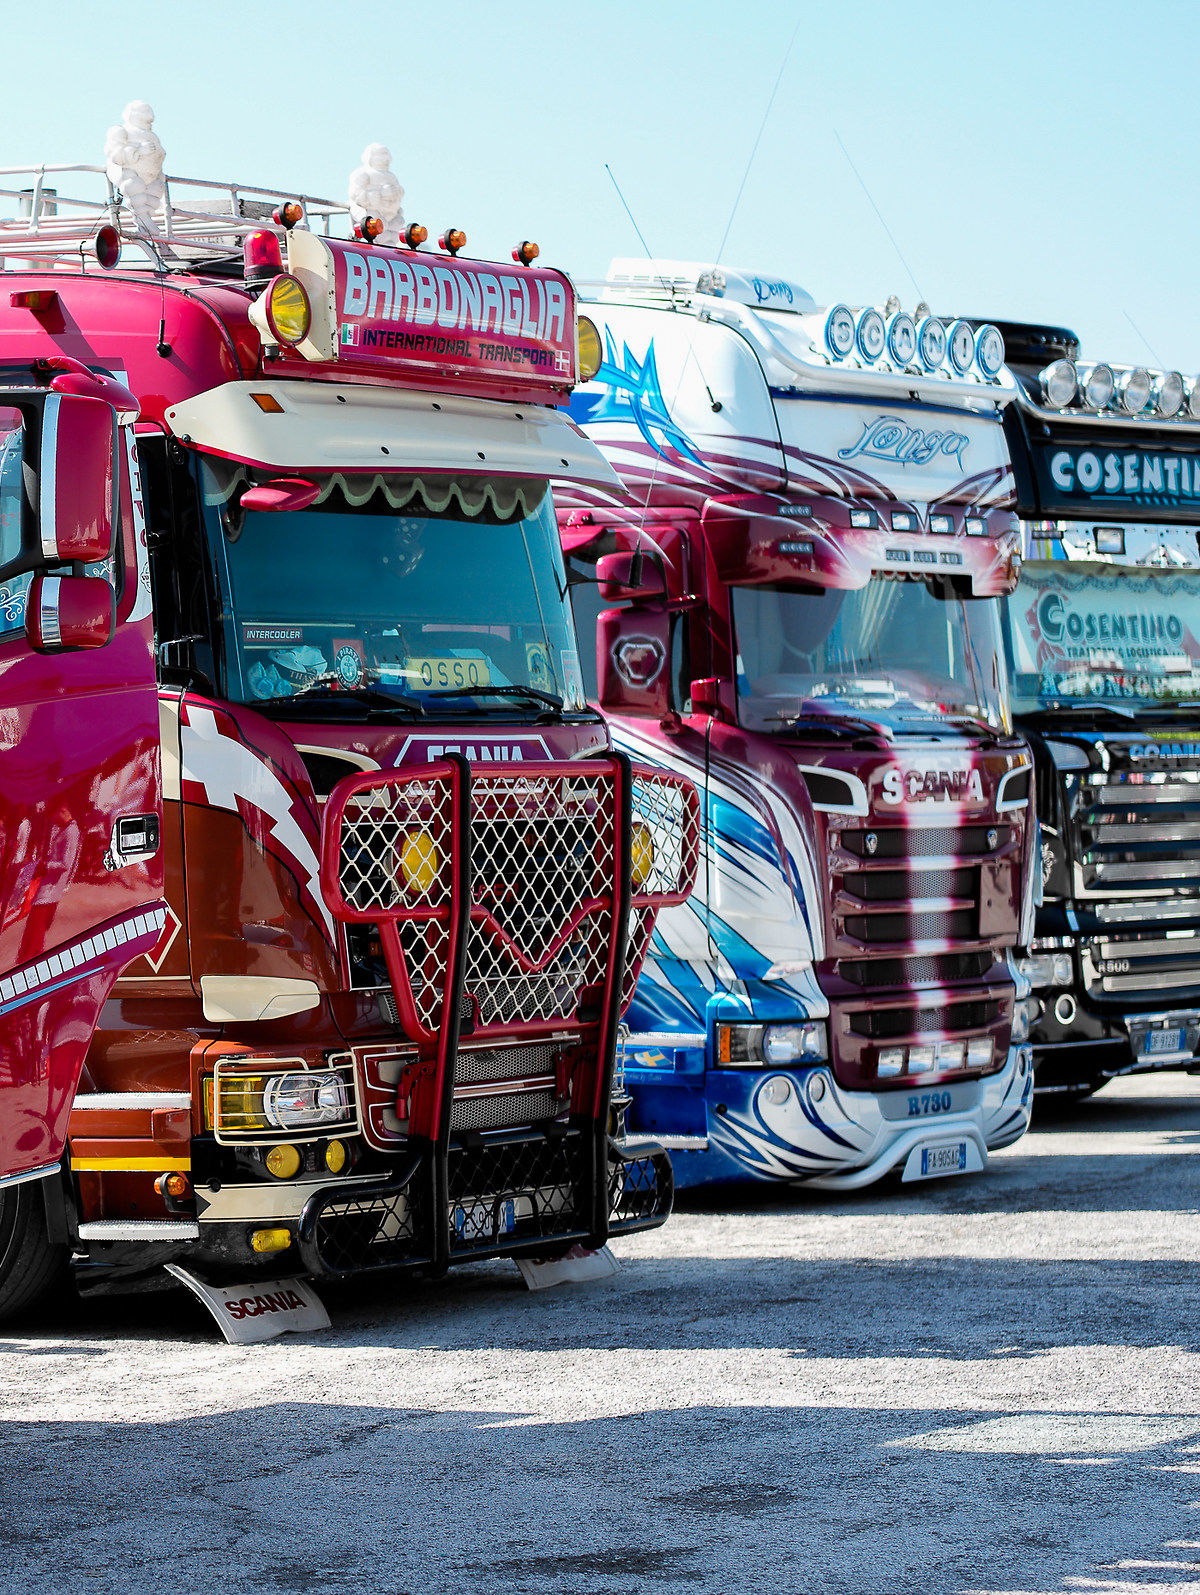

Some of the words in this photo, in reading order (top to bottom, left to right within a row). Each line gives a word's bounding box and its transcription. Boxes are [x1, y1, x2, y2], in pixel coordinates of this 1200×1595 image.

[343, 250, 566, 343] BARBONAGLIA
[362, 329, 472, 359] INTERNATIONAL
[478, 342, 556, 367] TRANSPORT
[1037, 589, 1184, 642] COSENTINO
[246, 629, 302, 640] INTERCOOLER
[421, 661, 479, 687] OSSO
[882, 768, 984, 805] SCANIA
[224, 1289, 308, 1320] SCANIA
